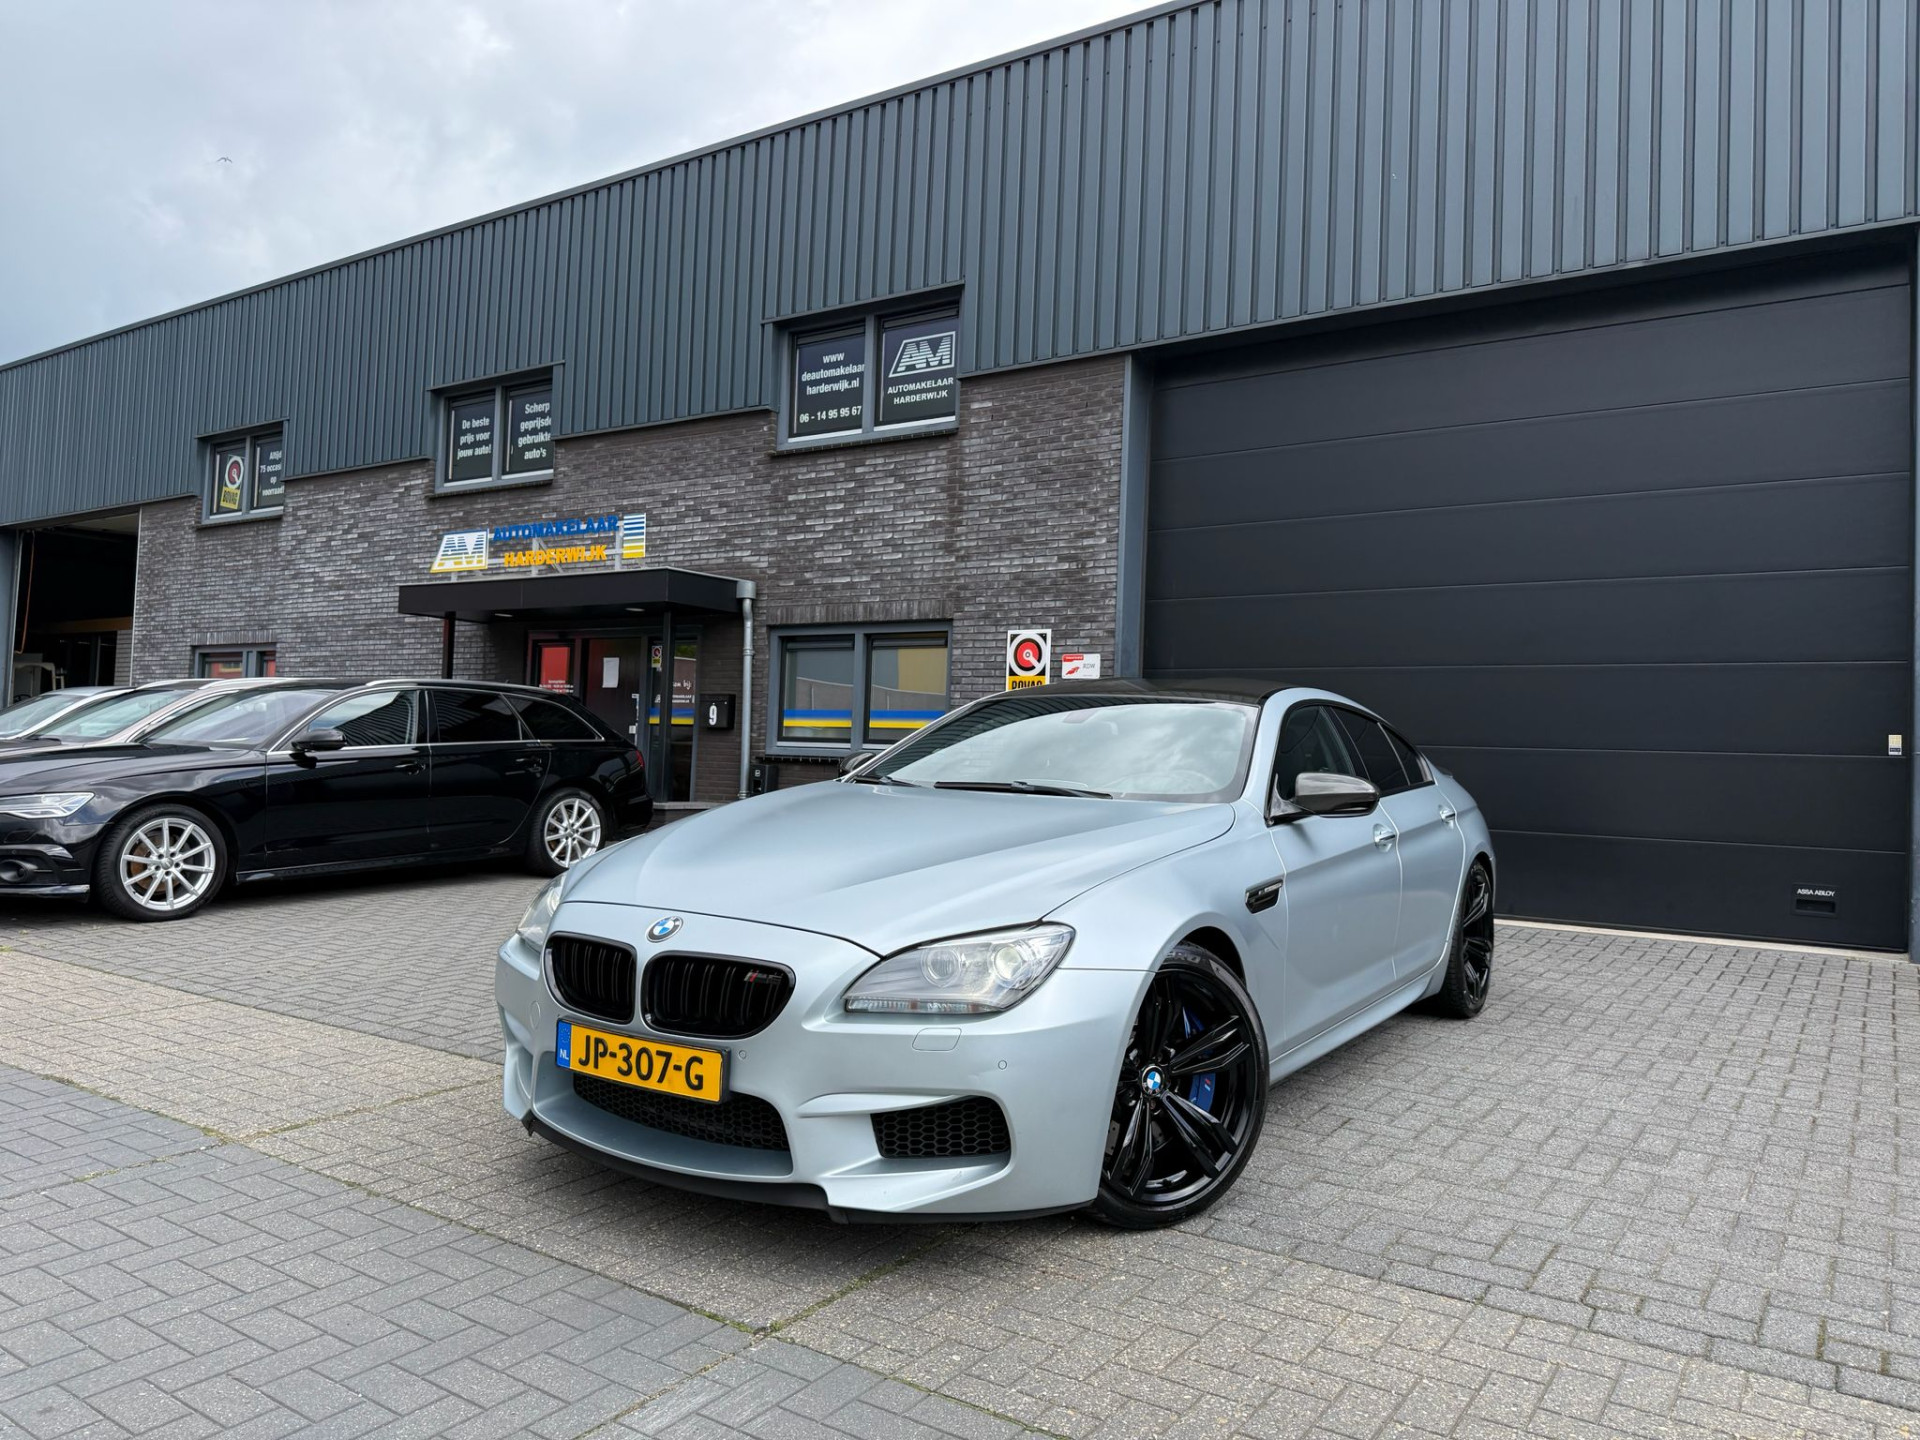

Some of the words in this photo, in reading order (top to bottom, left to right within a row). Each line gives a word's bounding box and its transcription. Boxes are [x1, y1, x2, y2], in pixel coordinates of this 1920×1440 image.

[823, 352, 845, 364] www
[806, 378, 860, 396] harderwijk.nl
[887, 377, 954, 394] AUTOMAKELAAR
[893, 390, 948, 405] HARDERWIJK
[525, 402, 550, 414] Scherp
[799, 413, 809, 423] 06
[817, 410, 826, 420] 14
[828, 408, 838, 419] 95
[840, 407, 850, 418] 95
[851, 405, 862, 416] 67
[462, 420, 470, 429] De
[472, 417, 490, 428] beste
[460, 434, 474, 446] prijs
[476, 432, 491, 441] voor
[457, 447, 473, 460] jouw
[524, 448, 546, 460] auto's
[493, 515, 620, 541] AUTOMAKELAAR
[504, 544, 608, 567] HARDERWIJK
[709, 705, 718, 726] 9
[559, 1049, 570, 1061] NL
[578, 1034, 704, 1091] JP-307-G
